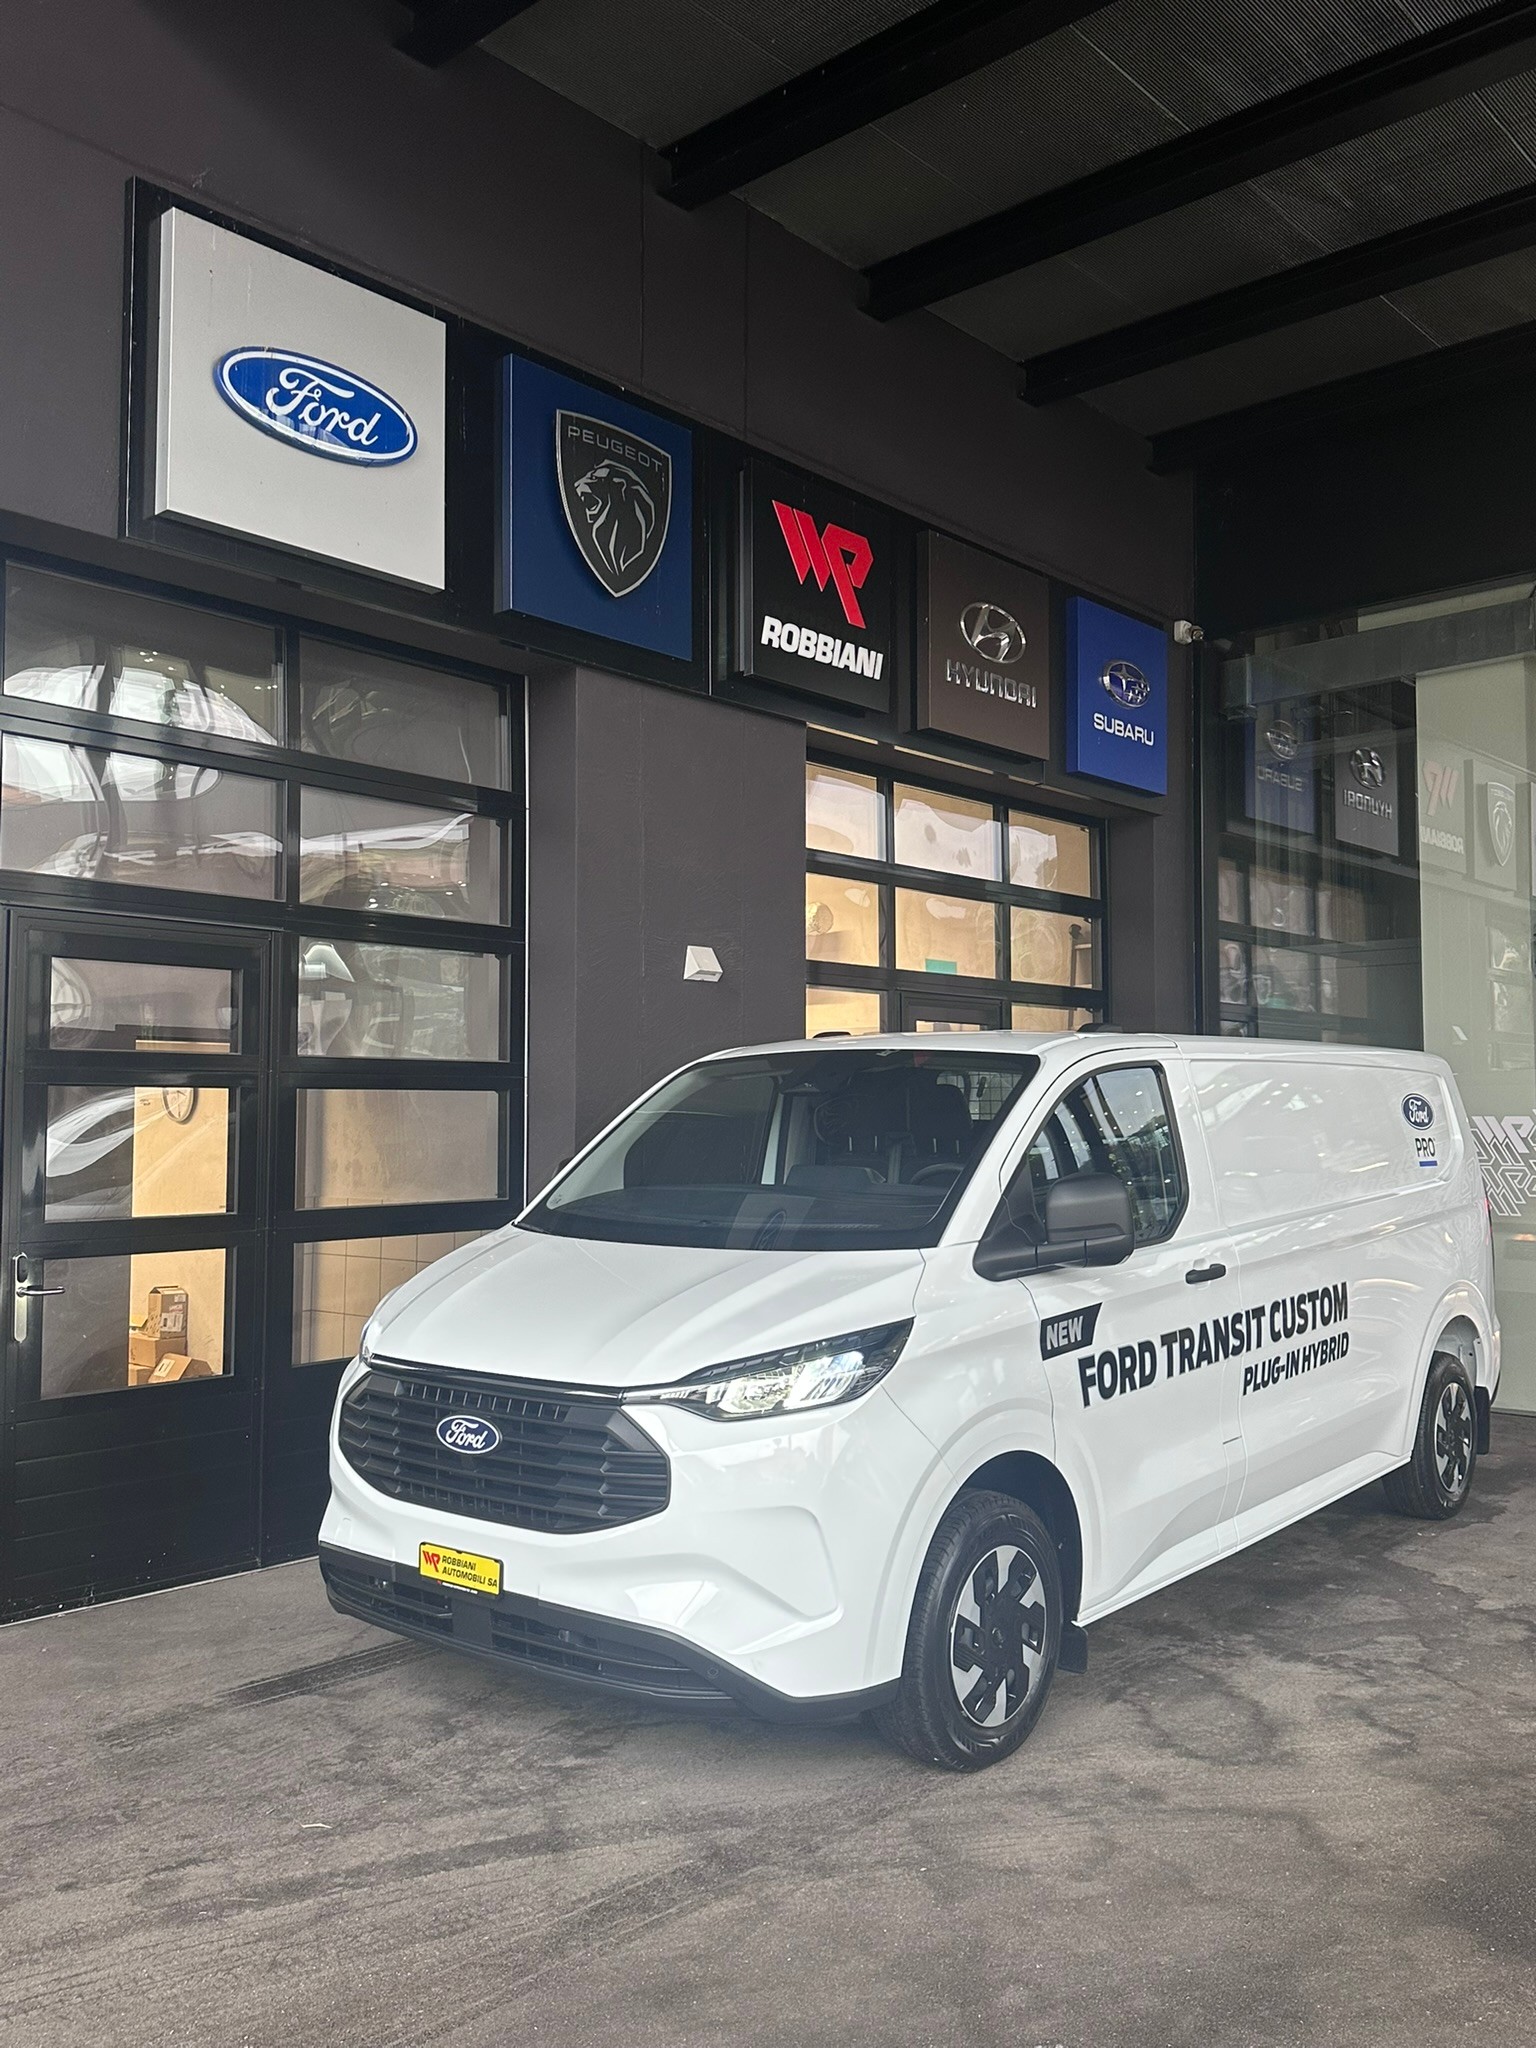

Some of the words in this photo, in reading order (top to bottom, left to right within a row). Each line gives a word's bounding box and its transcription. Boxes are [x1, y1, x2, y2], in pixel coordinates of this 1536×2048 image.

[265, 366, 379, 447] Ford
[567, 424, 663, 473] PEUGEOT
[760, 614, 884, 681] ROBBIANI
[946, 657, 1037, 709] HYUNDAI
[1093, 711, 1155, 747] SUBARU
[1408, 1098, 1430, 1123] Ford
[1415, 1137, 1436, 1158] PRO
[1046, 1316, 1085, 1350] NEW
[1077, 1339, 1158, 1409] FORD
[1160, 1305, 1267, 1380] TRANSIT
[1268, 1281, 1349, 1344] CUSTOM
[1242, 1357, 1301, 1397] PLUG-IN
[1300, 1331, 1349, 1377] HYBRID
[445, 1418, 489, 1450] Ford
[441, 1566, 487, 1585] AUTOMOBILI
[487, 1577, 498, 1588] SA
[442, 1555, 477, 1572] ROBBIANI
